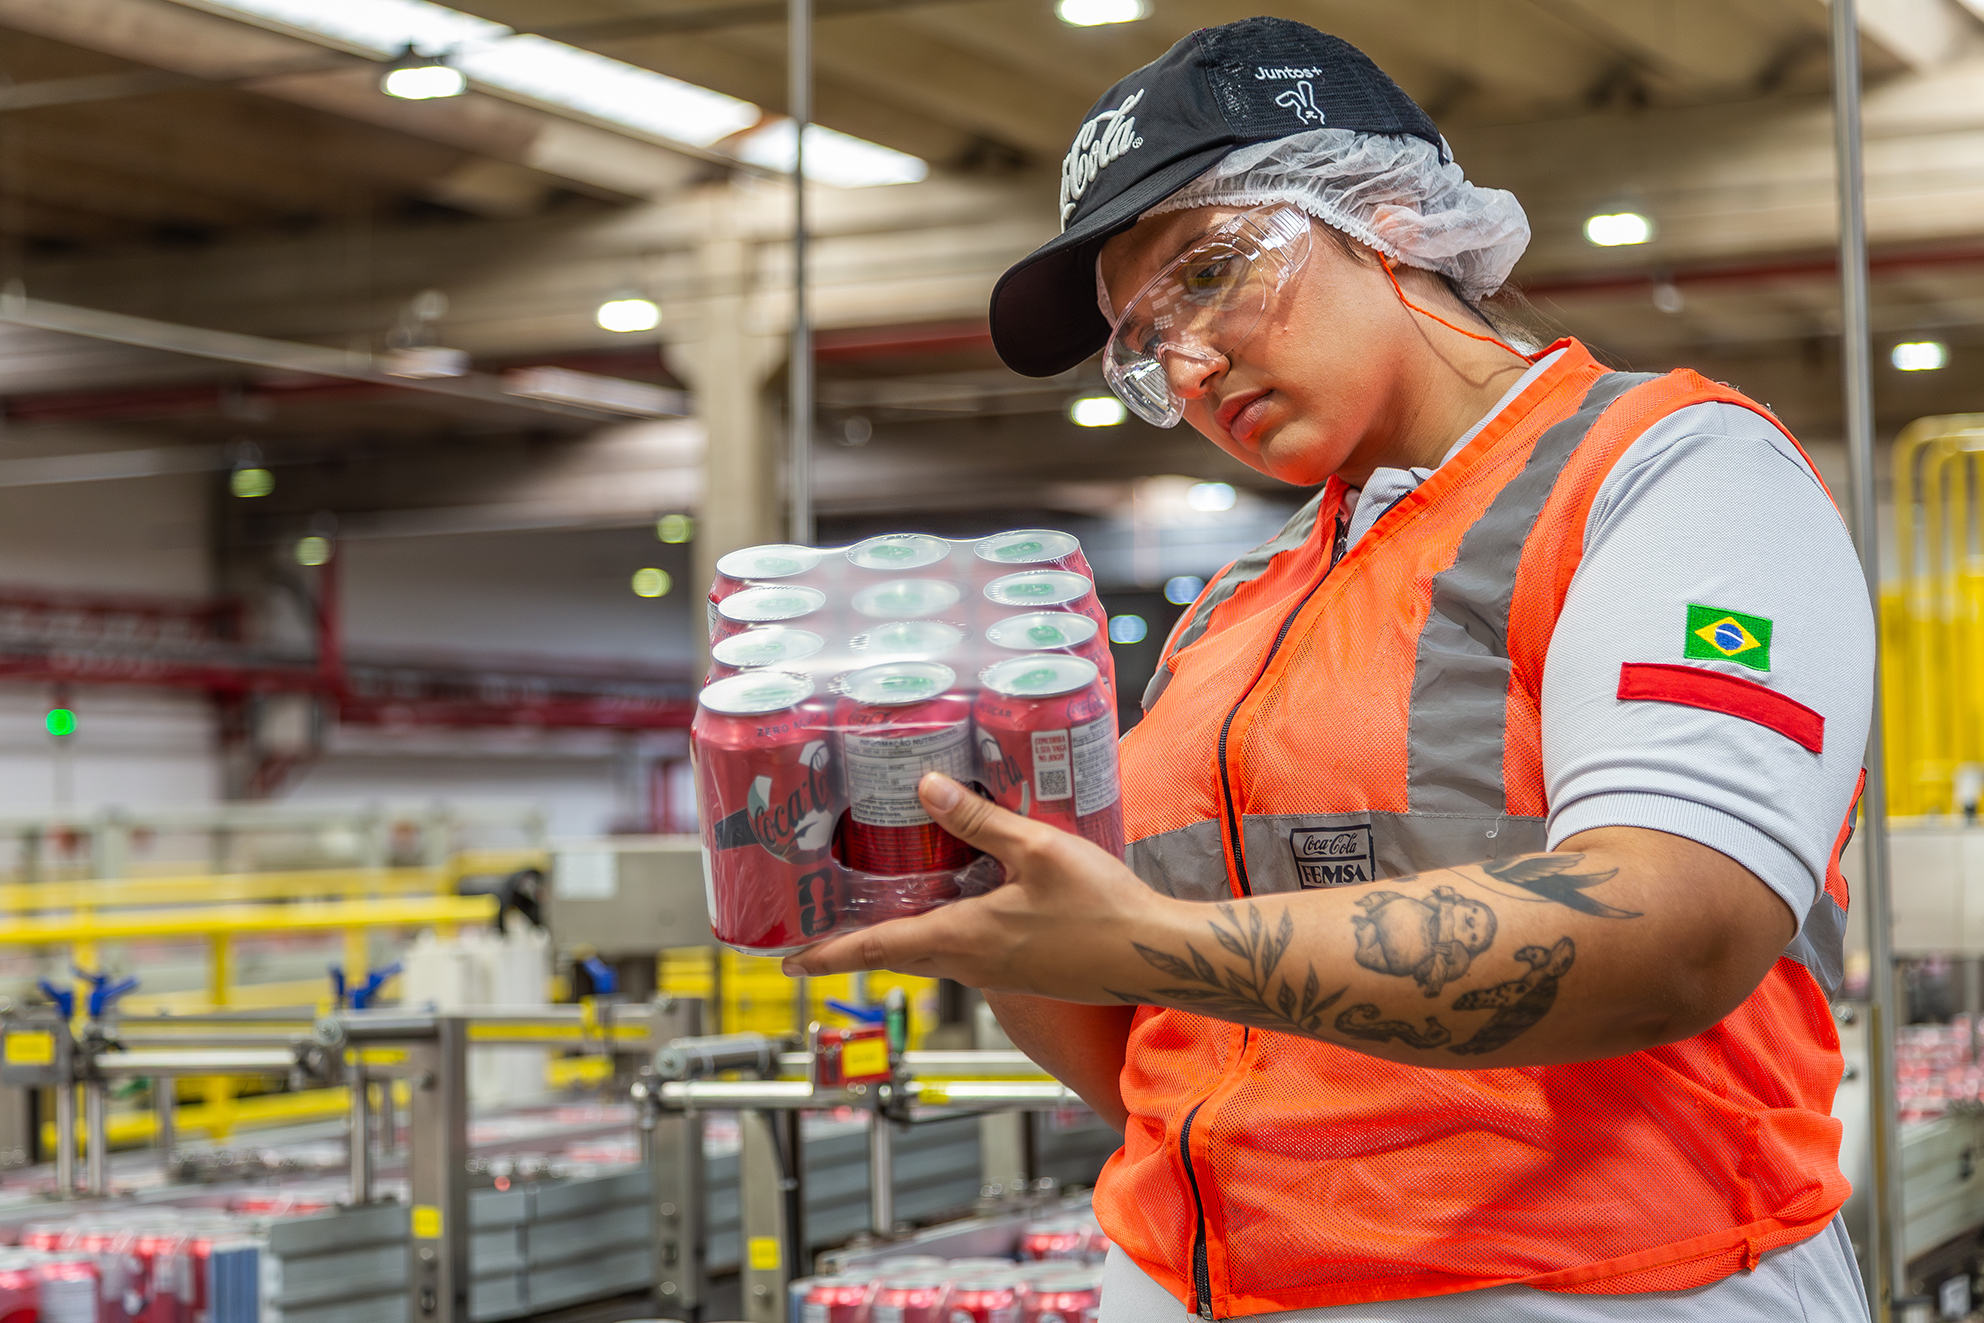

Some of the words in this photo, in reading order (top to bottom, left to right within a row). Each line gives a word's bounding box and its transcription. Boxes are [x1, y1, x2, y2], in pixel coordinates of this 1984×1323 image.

[1255, 66, 1323, 80] Juntos+
[756, 724, 789, 737] ZERO
[1303, 833, 1358, 856] Coca-Cola
[1301, 864, 1369, 884] FEMSA
